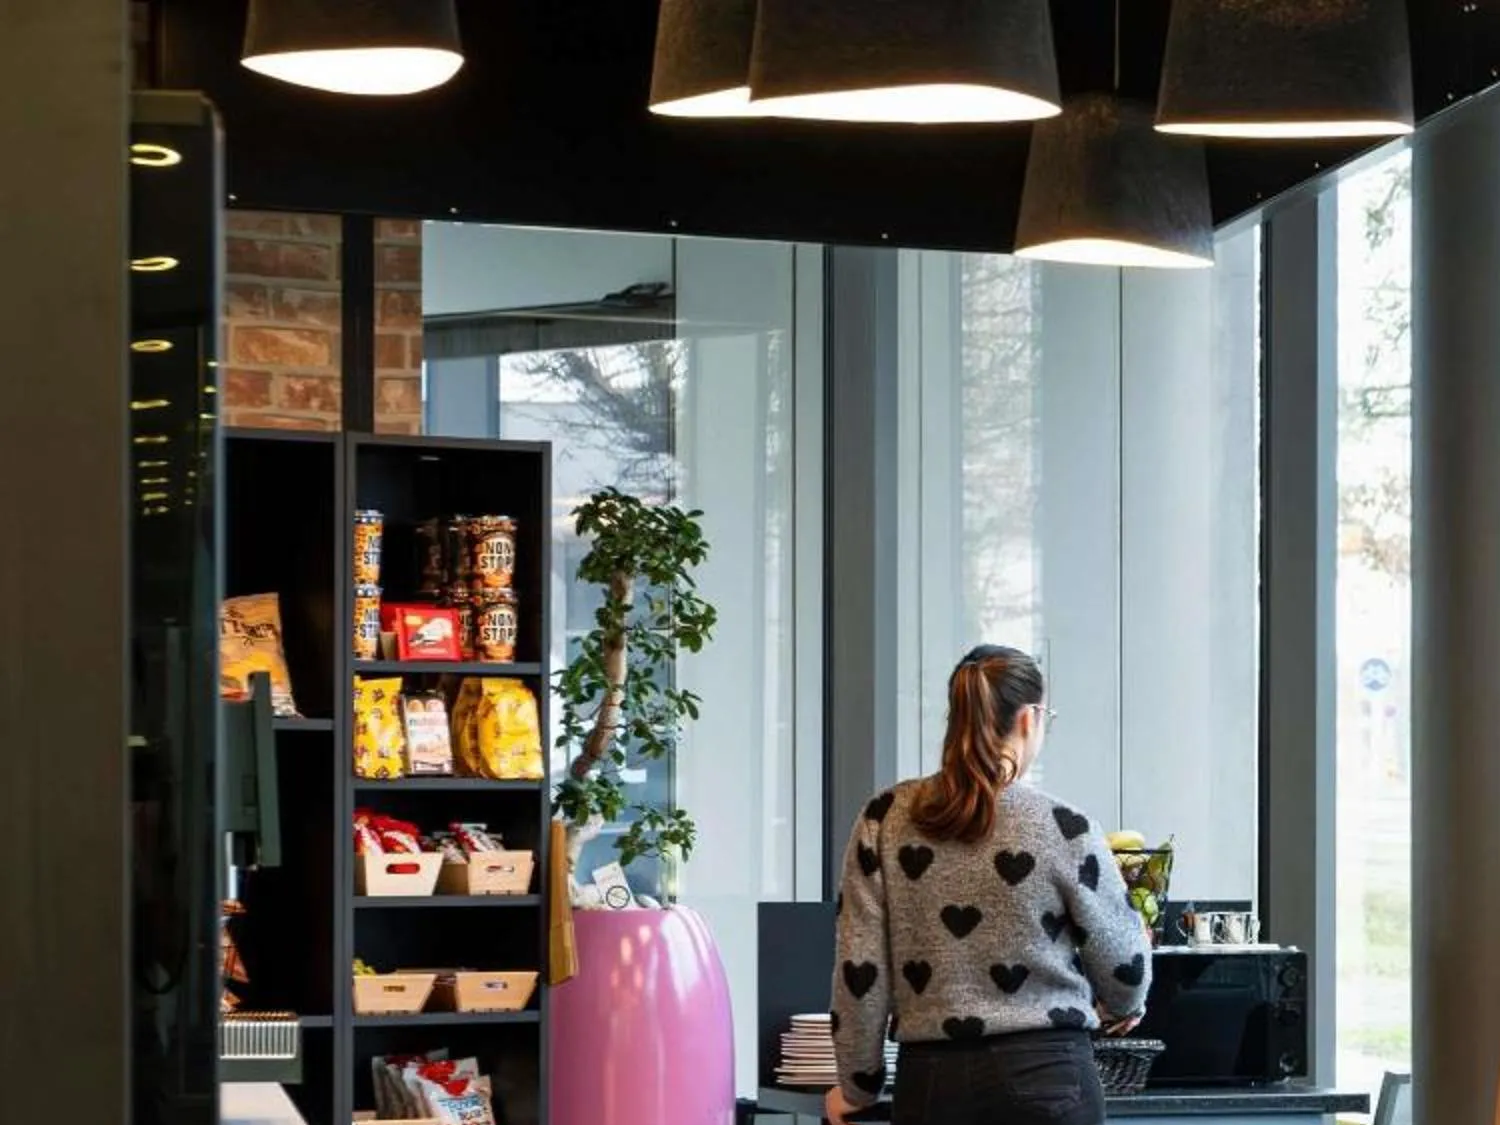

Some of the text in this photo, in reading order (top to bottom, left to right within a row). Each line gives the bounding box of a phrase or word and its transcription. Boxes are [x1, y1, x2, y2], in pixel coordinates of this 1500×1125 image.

[485, 541, 512, 554] NON
[481, 556, 513, 569] STOP
[487, 613, 514, 627] NON
[483, 627, 514, 641] STOP
